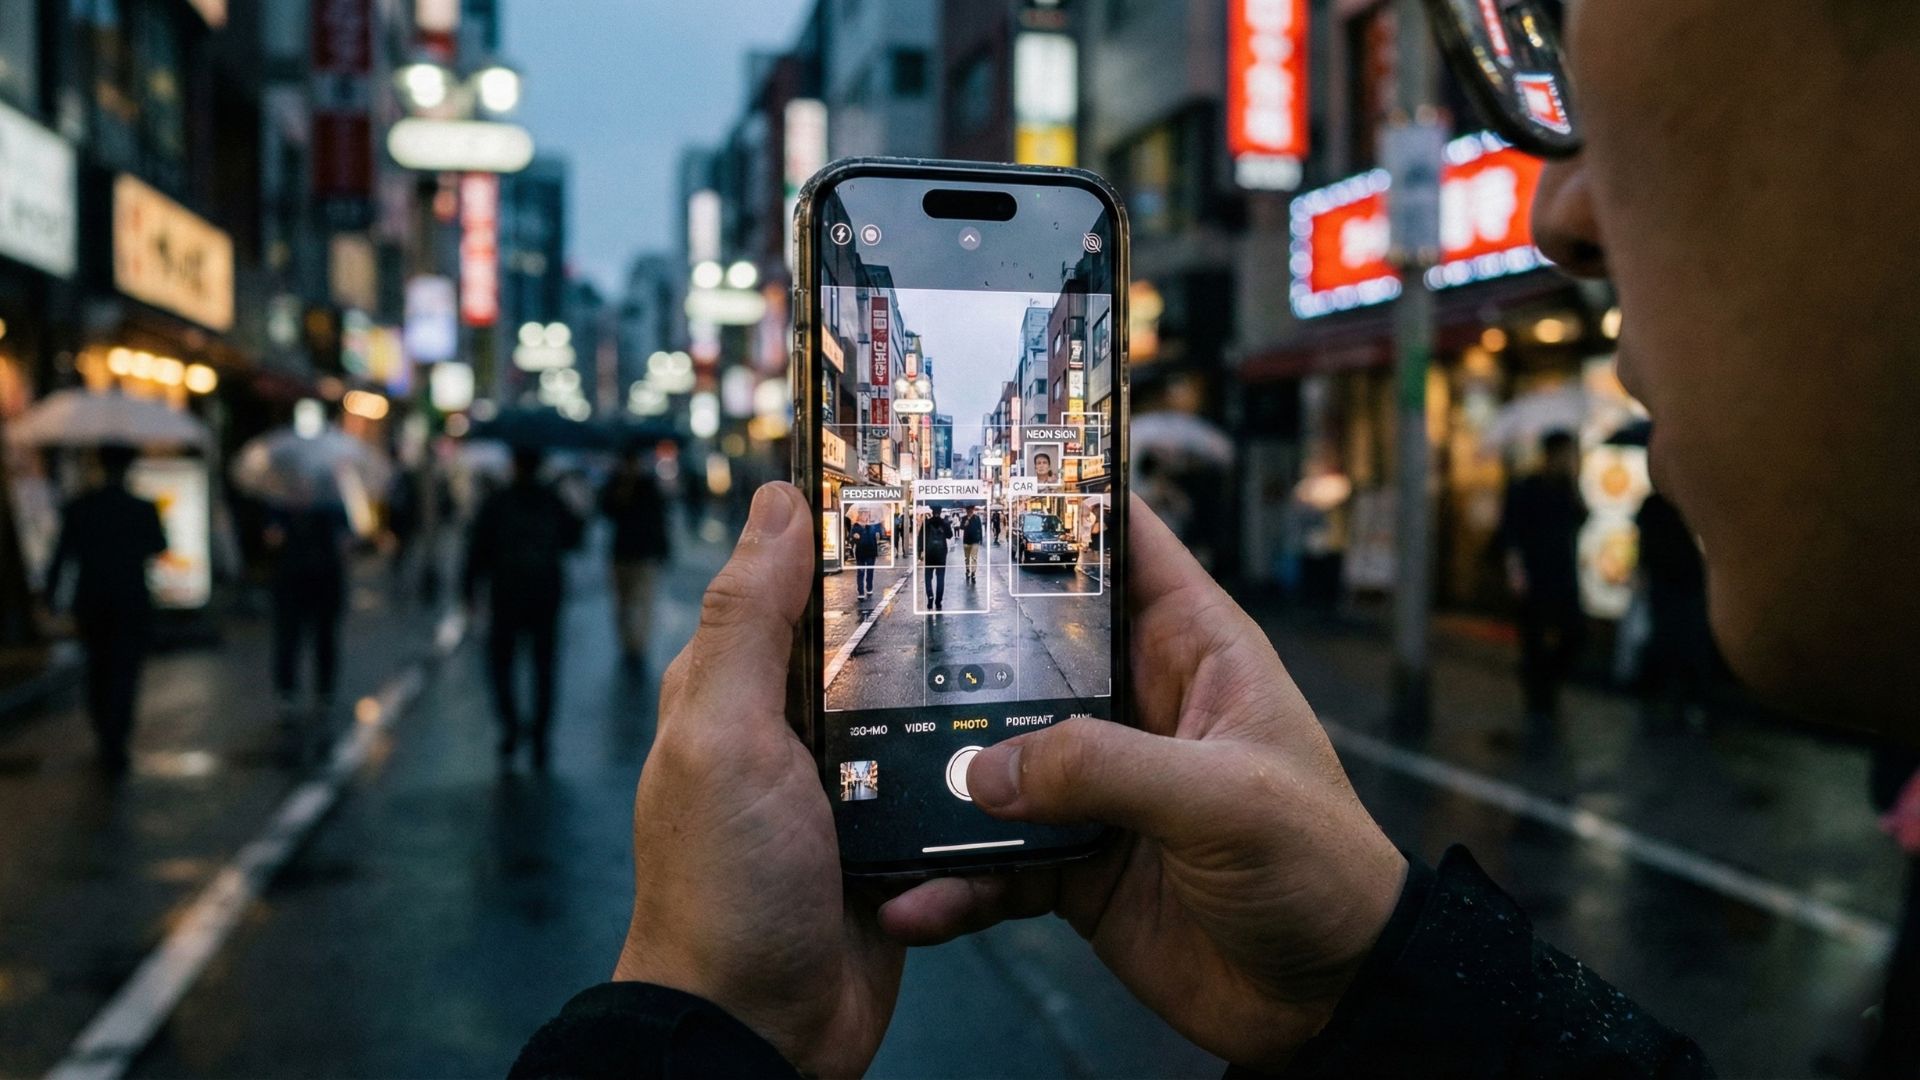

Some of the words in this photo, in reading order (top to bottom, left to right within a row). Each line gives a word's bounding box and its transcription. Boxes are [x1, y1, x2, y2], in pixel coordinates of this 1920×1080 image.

[1026, 429, 1053, 439] NEON
[918, 485, 979, 494] PEDESTRIAN
[1012, 482, 1033, 491] CAR
[842, 488, 901, 499] PEDESTRIAN
[904, 721, 936, 733] VIDEO
[953, 718, 988, 730] PHOTO
